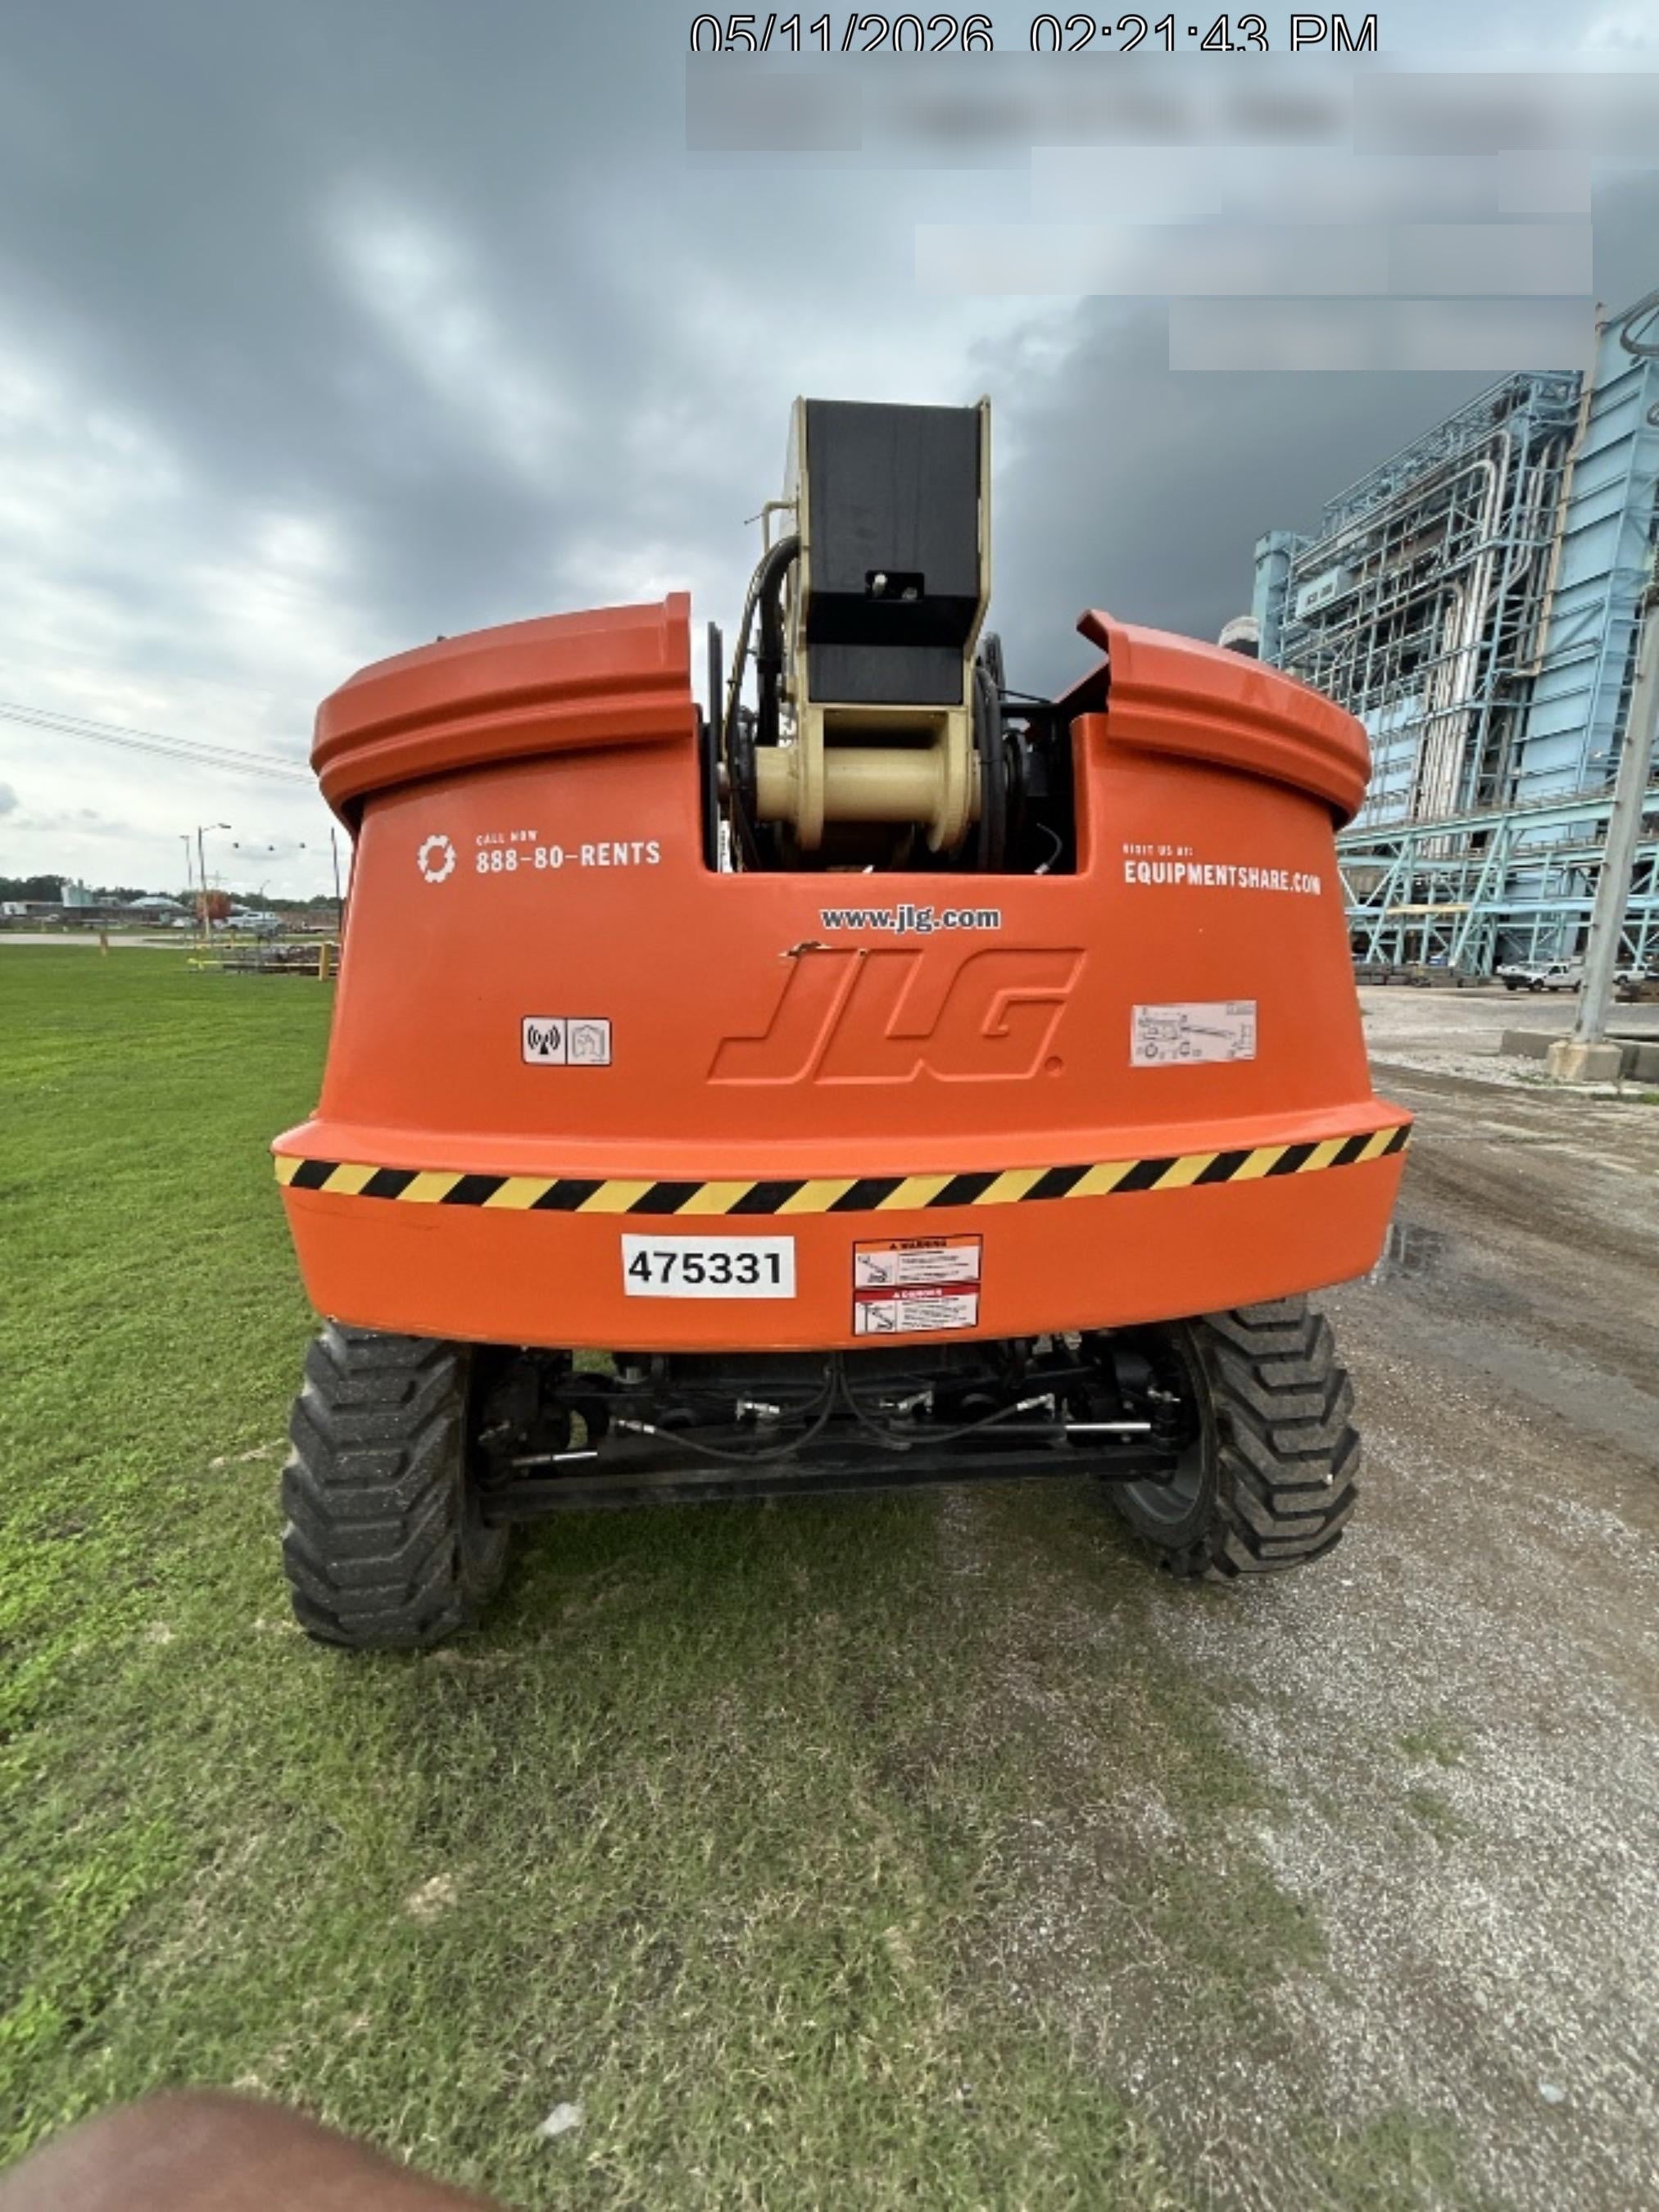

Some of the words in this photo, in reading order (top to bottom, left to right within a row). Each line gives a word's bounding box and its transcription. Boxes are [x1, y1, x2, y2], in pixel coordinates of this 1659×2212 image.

[476, 841, 661, 873] 888-80-RENTS
[1124, 860, 1321, 896] EQUIPMENTSHARE.COM
[820, 904, 1001, 934] www.jlg.com
[628, 1250, 781, 1285] 475331
